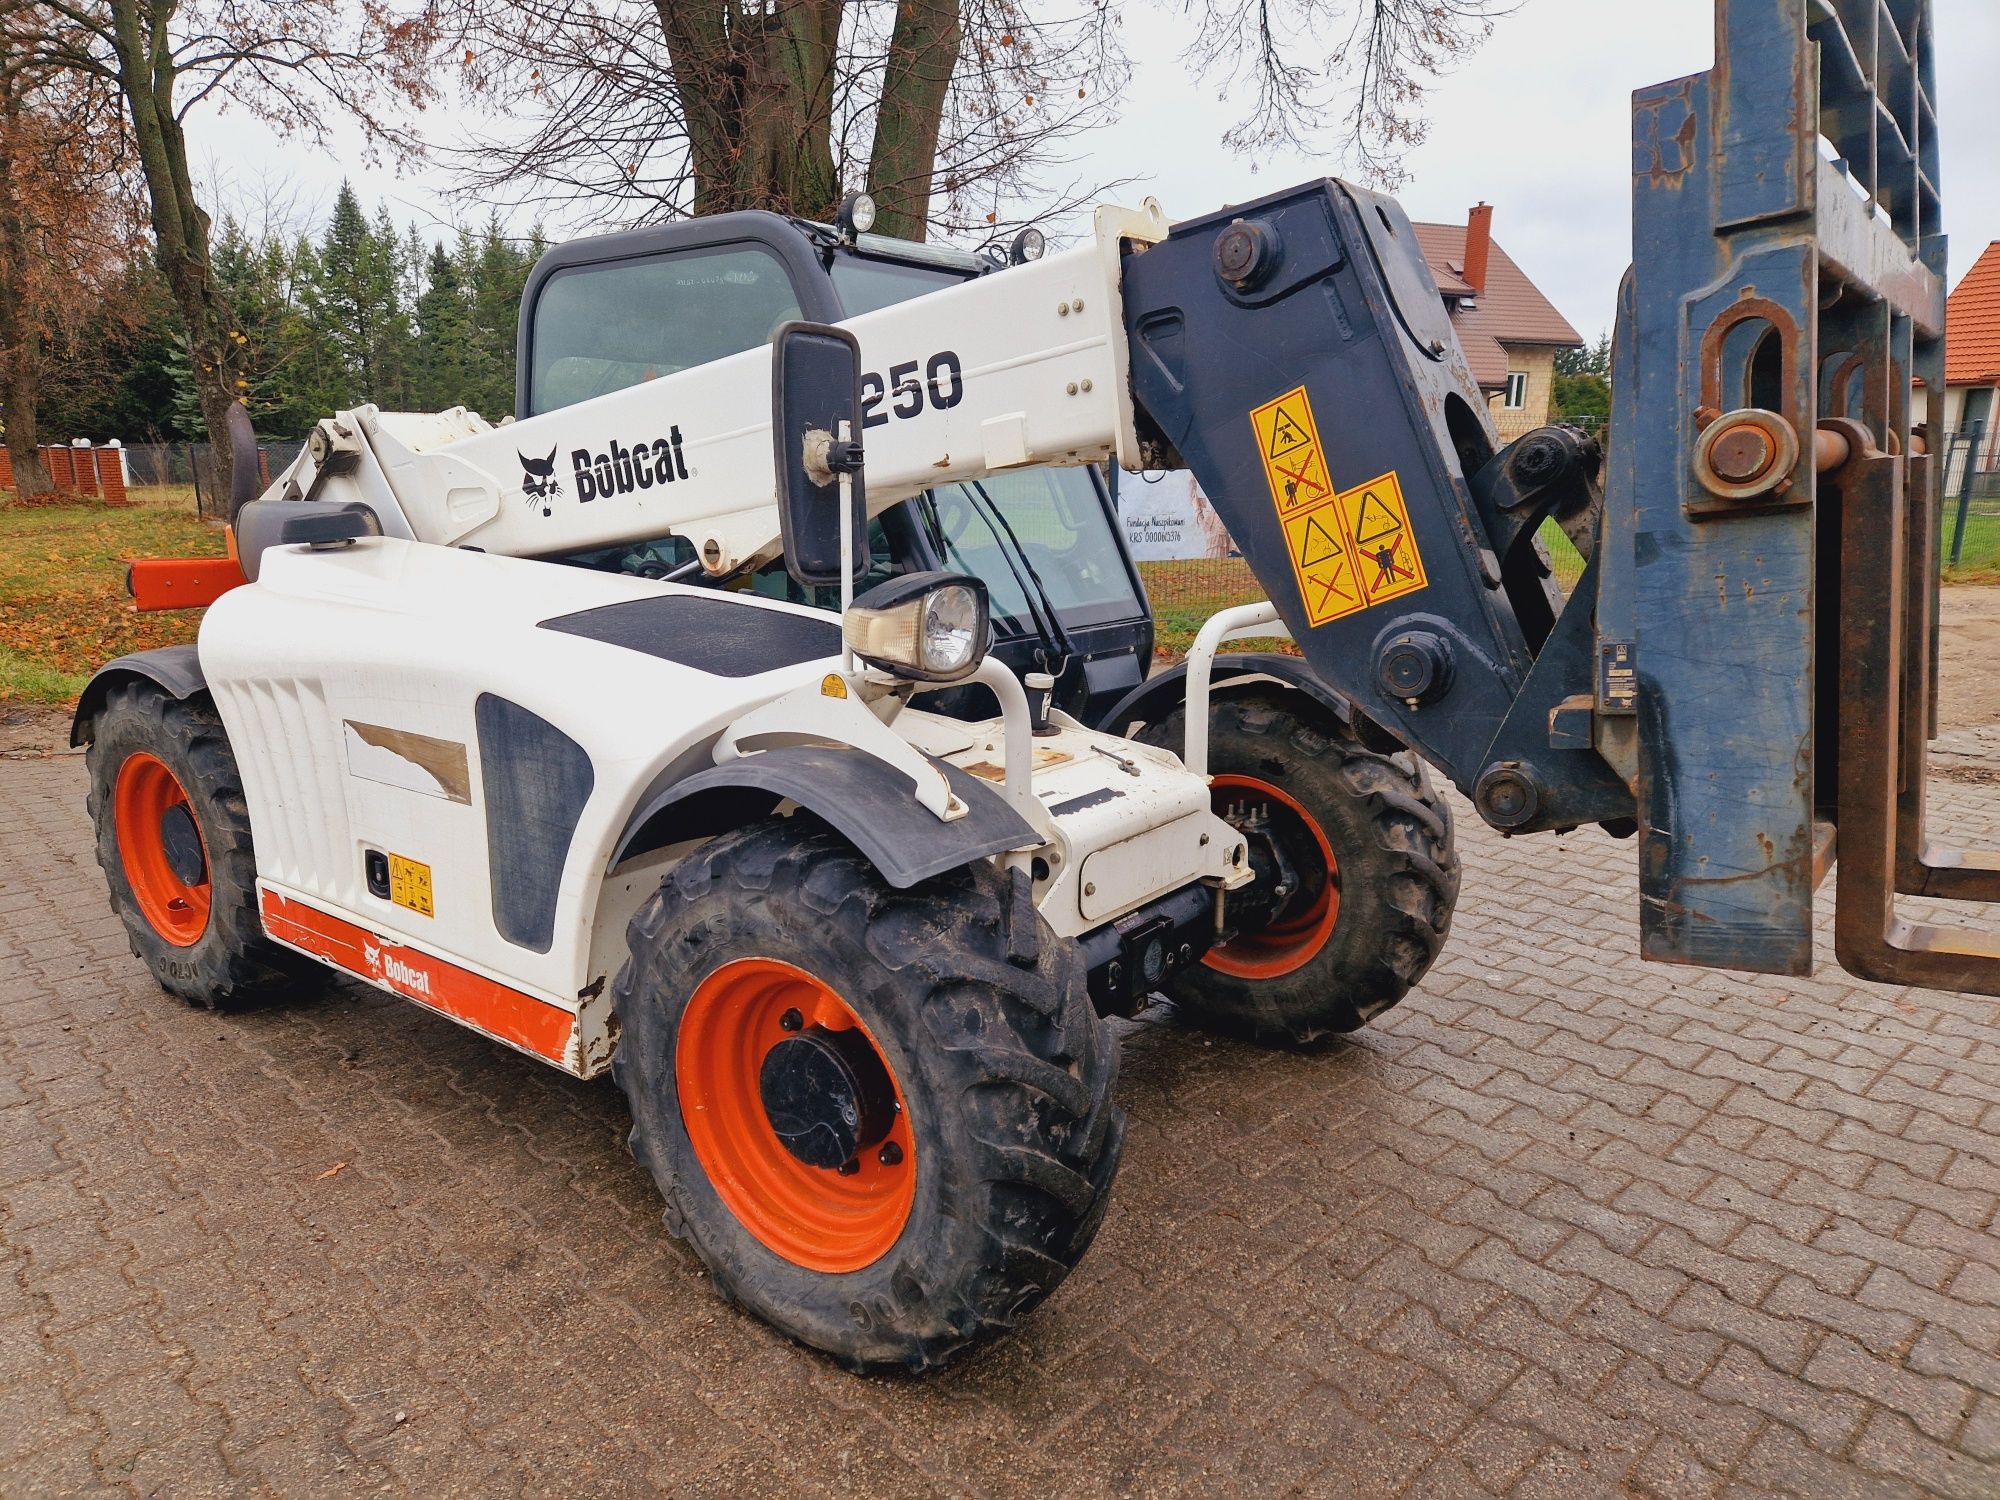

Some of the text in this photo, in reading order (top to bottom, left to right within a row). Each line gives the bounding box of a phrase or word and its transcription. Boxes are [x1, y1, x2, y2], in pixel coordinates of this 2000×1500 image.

[861, 350, 963, 429] 250
[571, 425, 689, 504] Bobcat
[1126, 516, 1150, 531] Fundacja
[1129, 531, 1143, 543] KRS
[384, 954, 430, 995] Bobcat
